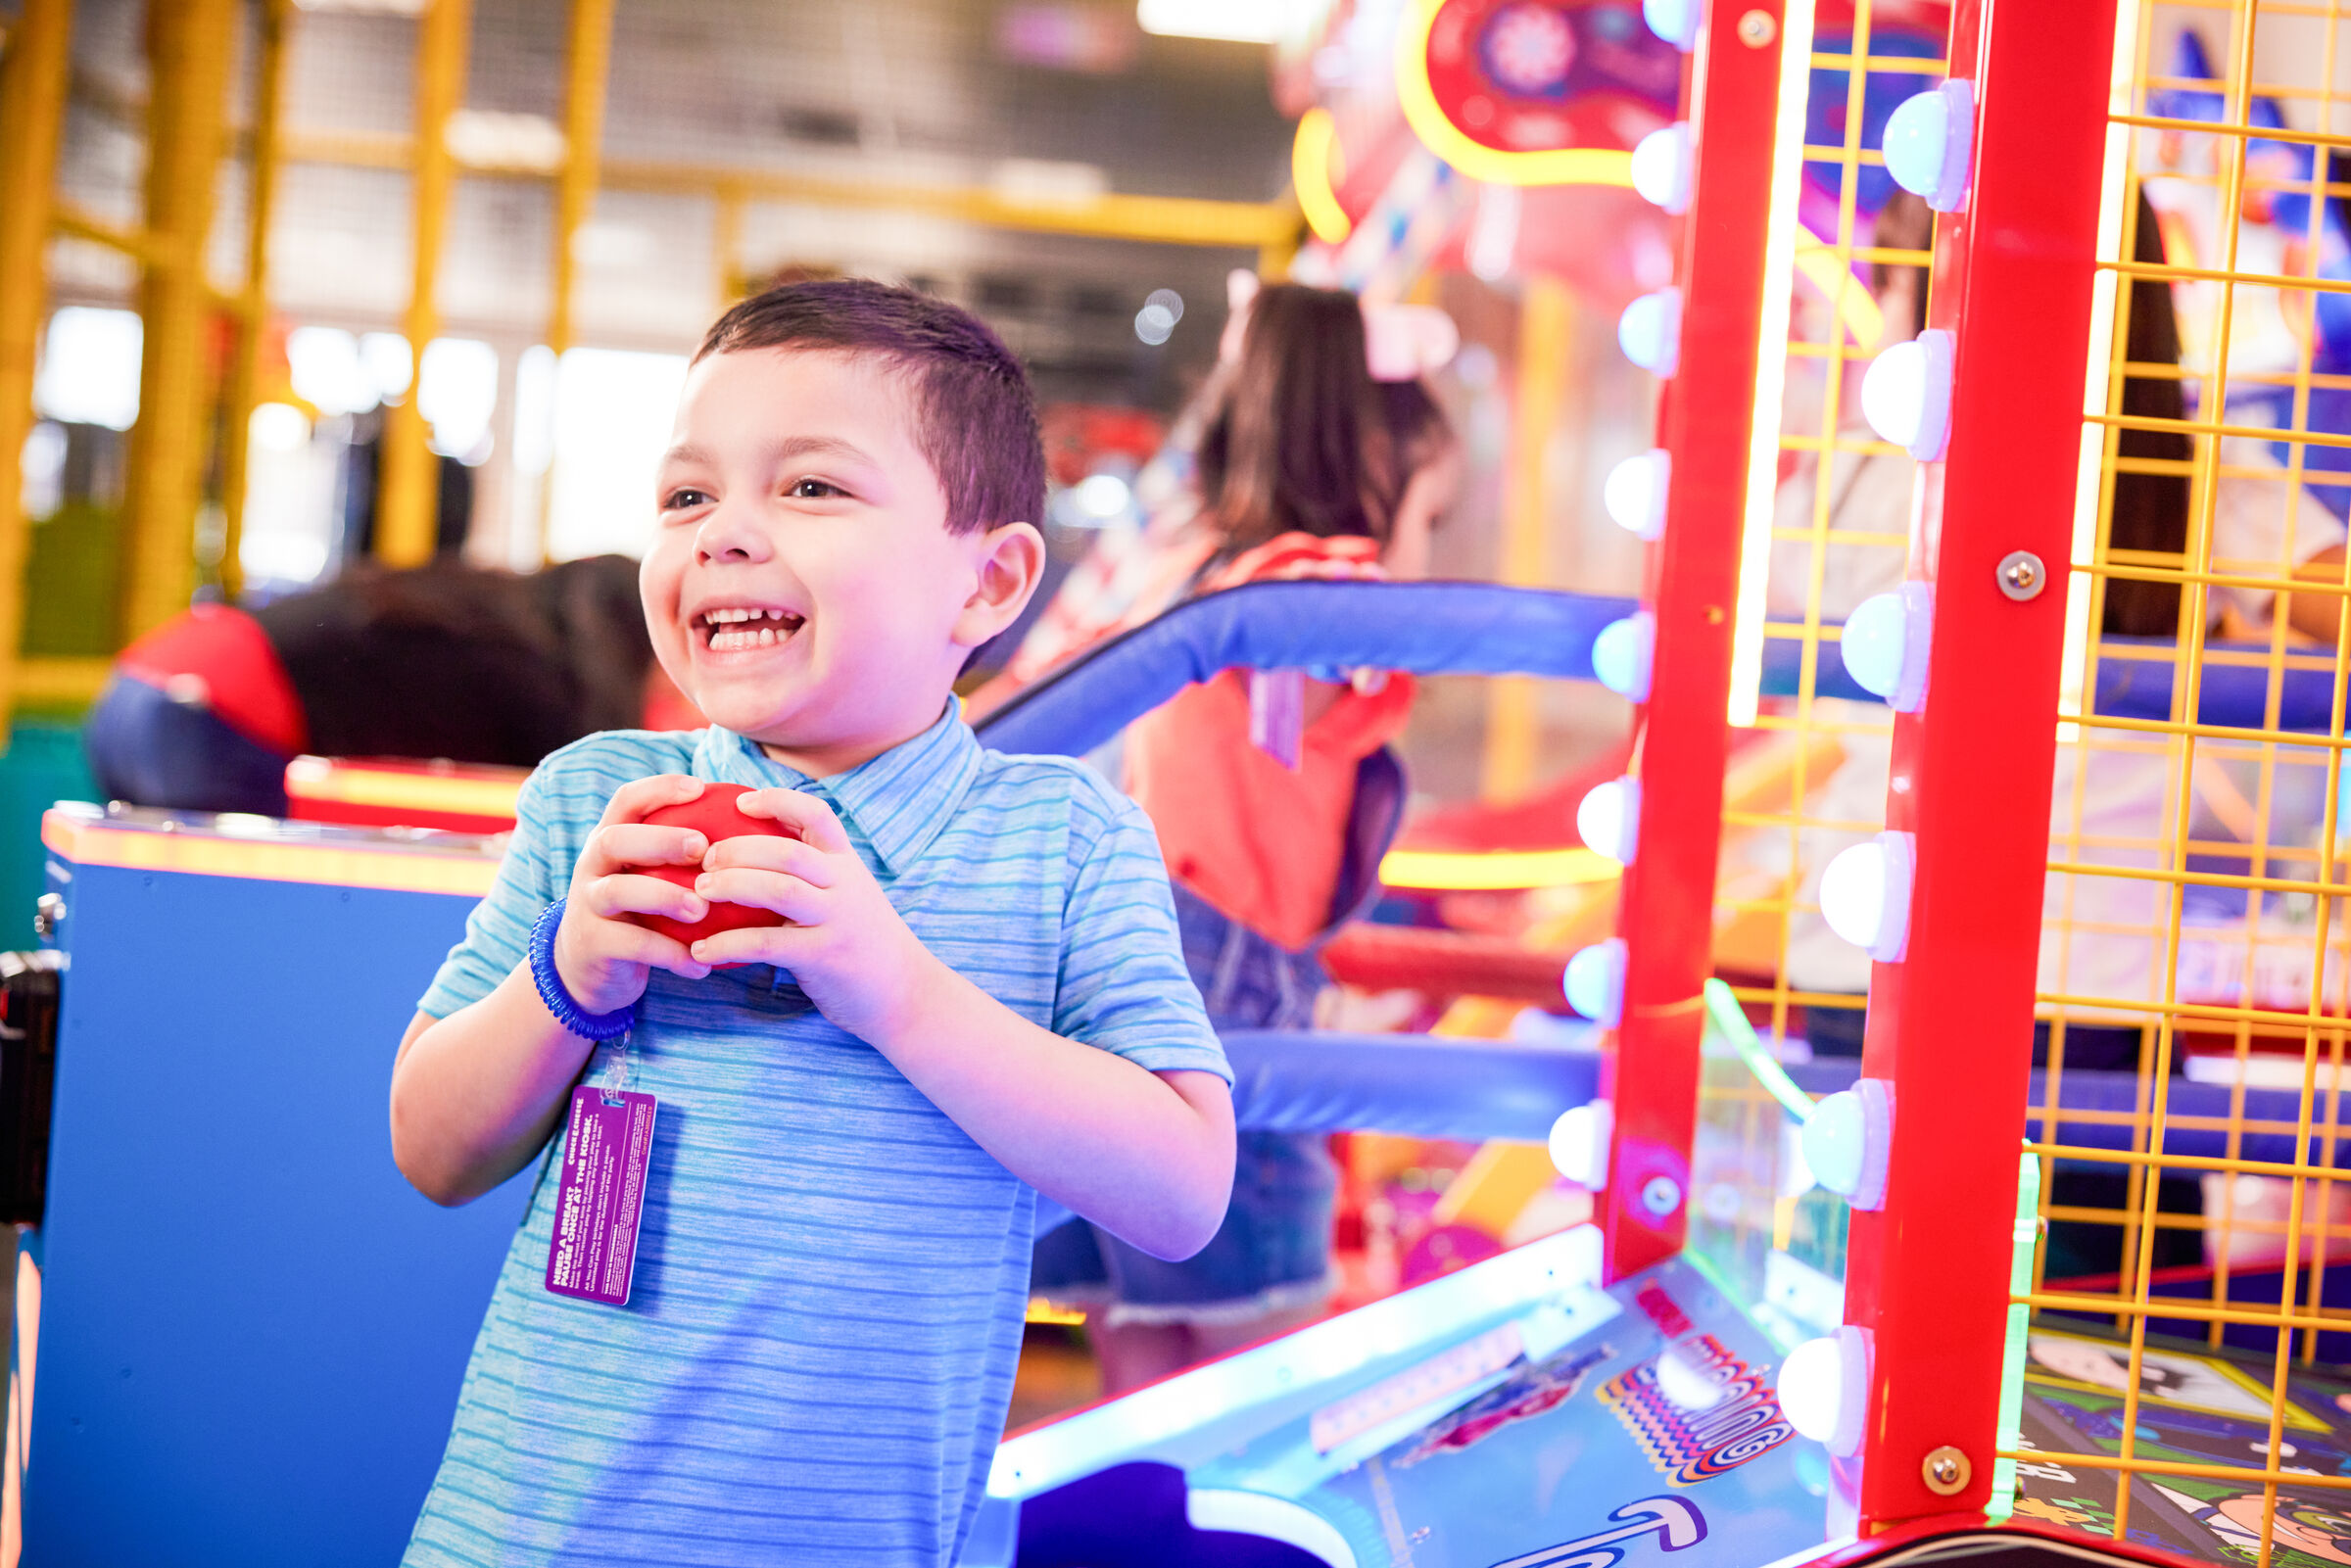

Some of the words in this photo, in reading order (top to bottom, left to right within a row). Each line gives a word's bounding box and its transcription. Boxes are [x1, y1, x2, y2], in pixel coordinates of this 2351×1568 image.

[580, 1115, 593, 1157] KIOSK.
[576, 1159, 587, 1185] THE
[560, 1186, 574, 1236] BREAK?
[573, 1186, 582, 1204] AT
[567, 1206, 579, 1243] ONCE
[558, 1238, 567, 1249] A
[552, 1250, 564, 1285] NEED
[560, 1245, 573, 1287] PAUSE
[590, 1261, 599, 1292] Unlimited
